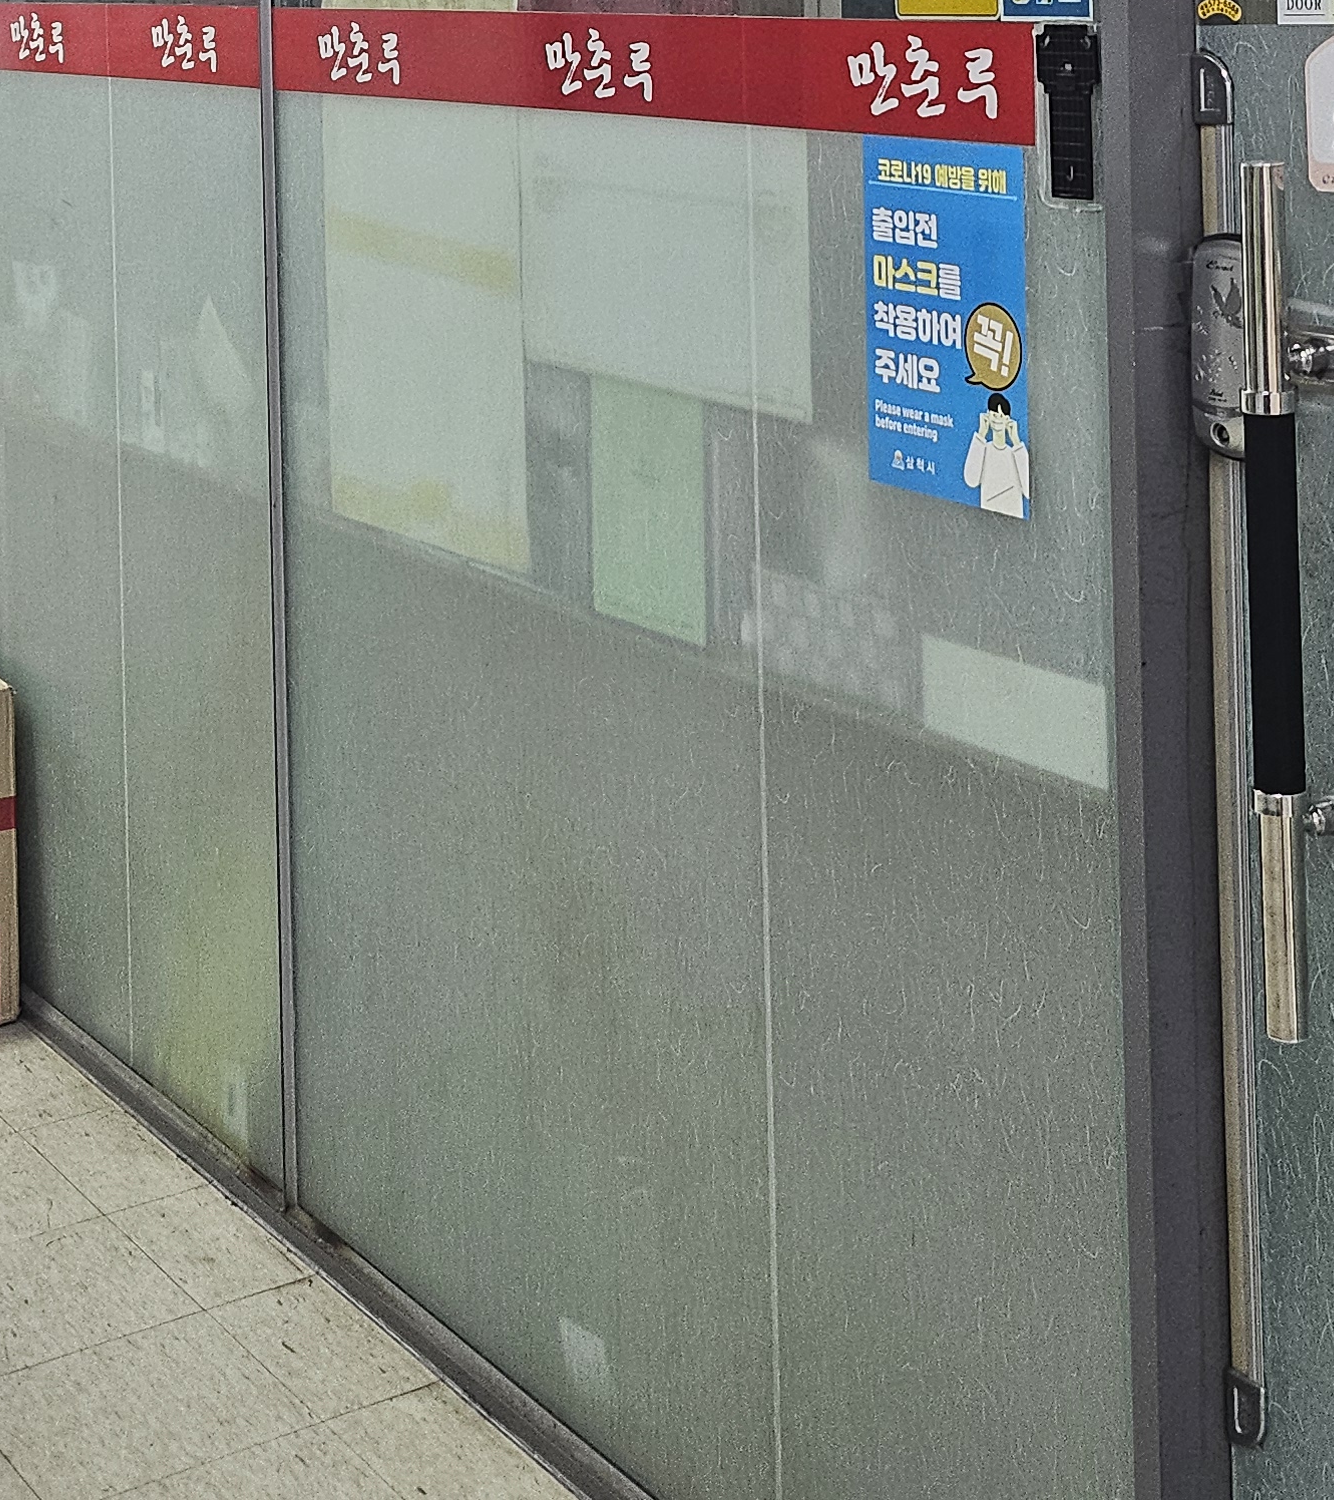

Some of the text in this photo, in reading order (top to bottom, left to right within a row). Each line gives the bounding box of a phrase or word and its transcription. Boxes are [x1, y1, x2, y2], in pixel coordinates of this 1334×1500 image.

[10, 12, 65, 64] 만춘루
[151, 14, 218, 73] 만춘루
[318, 22, 401, 85] 만춘루
[544, 28, 654, 102] 만춘루
[847, 33, 998, 120] 만춘루
[877, 158, 1007, 195] 코로나19 예방을 위해
[872, 207, 939, 249] 출입전
[873, 254, 962, 301] 마스크를
[873, 301, 963, 350] 착용하여
[973, 314, 1014, 378] 꼭!
[874, 348, 941, 393] 주세요
[875, 398, 954, 429] Please wear a mask
[875, 414, 938, 443] before entering
[905, 453, 936, 476] 삼척시
